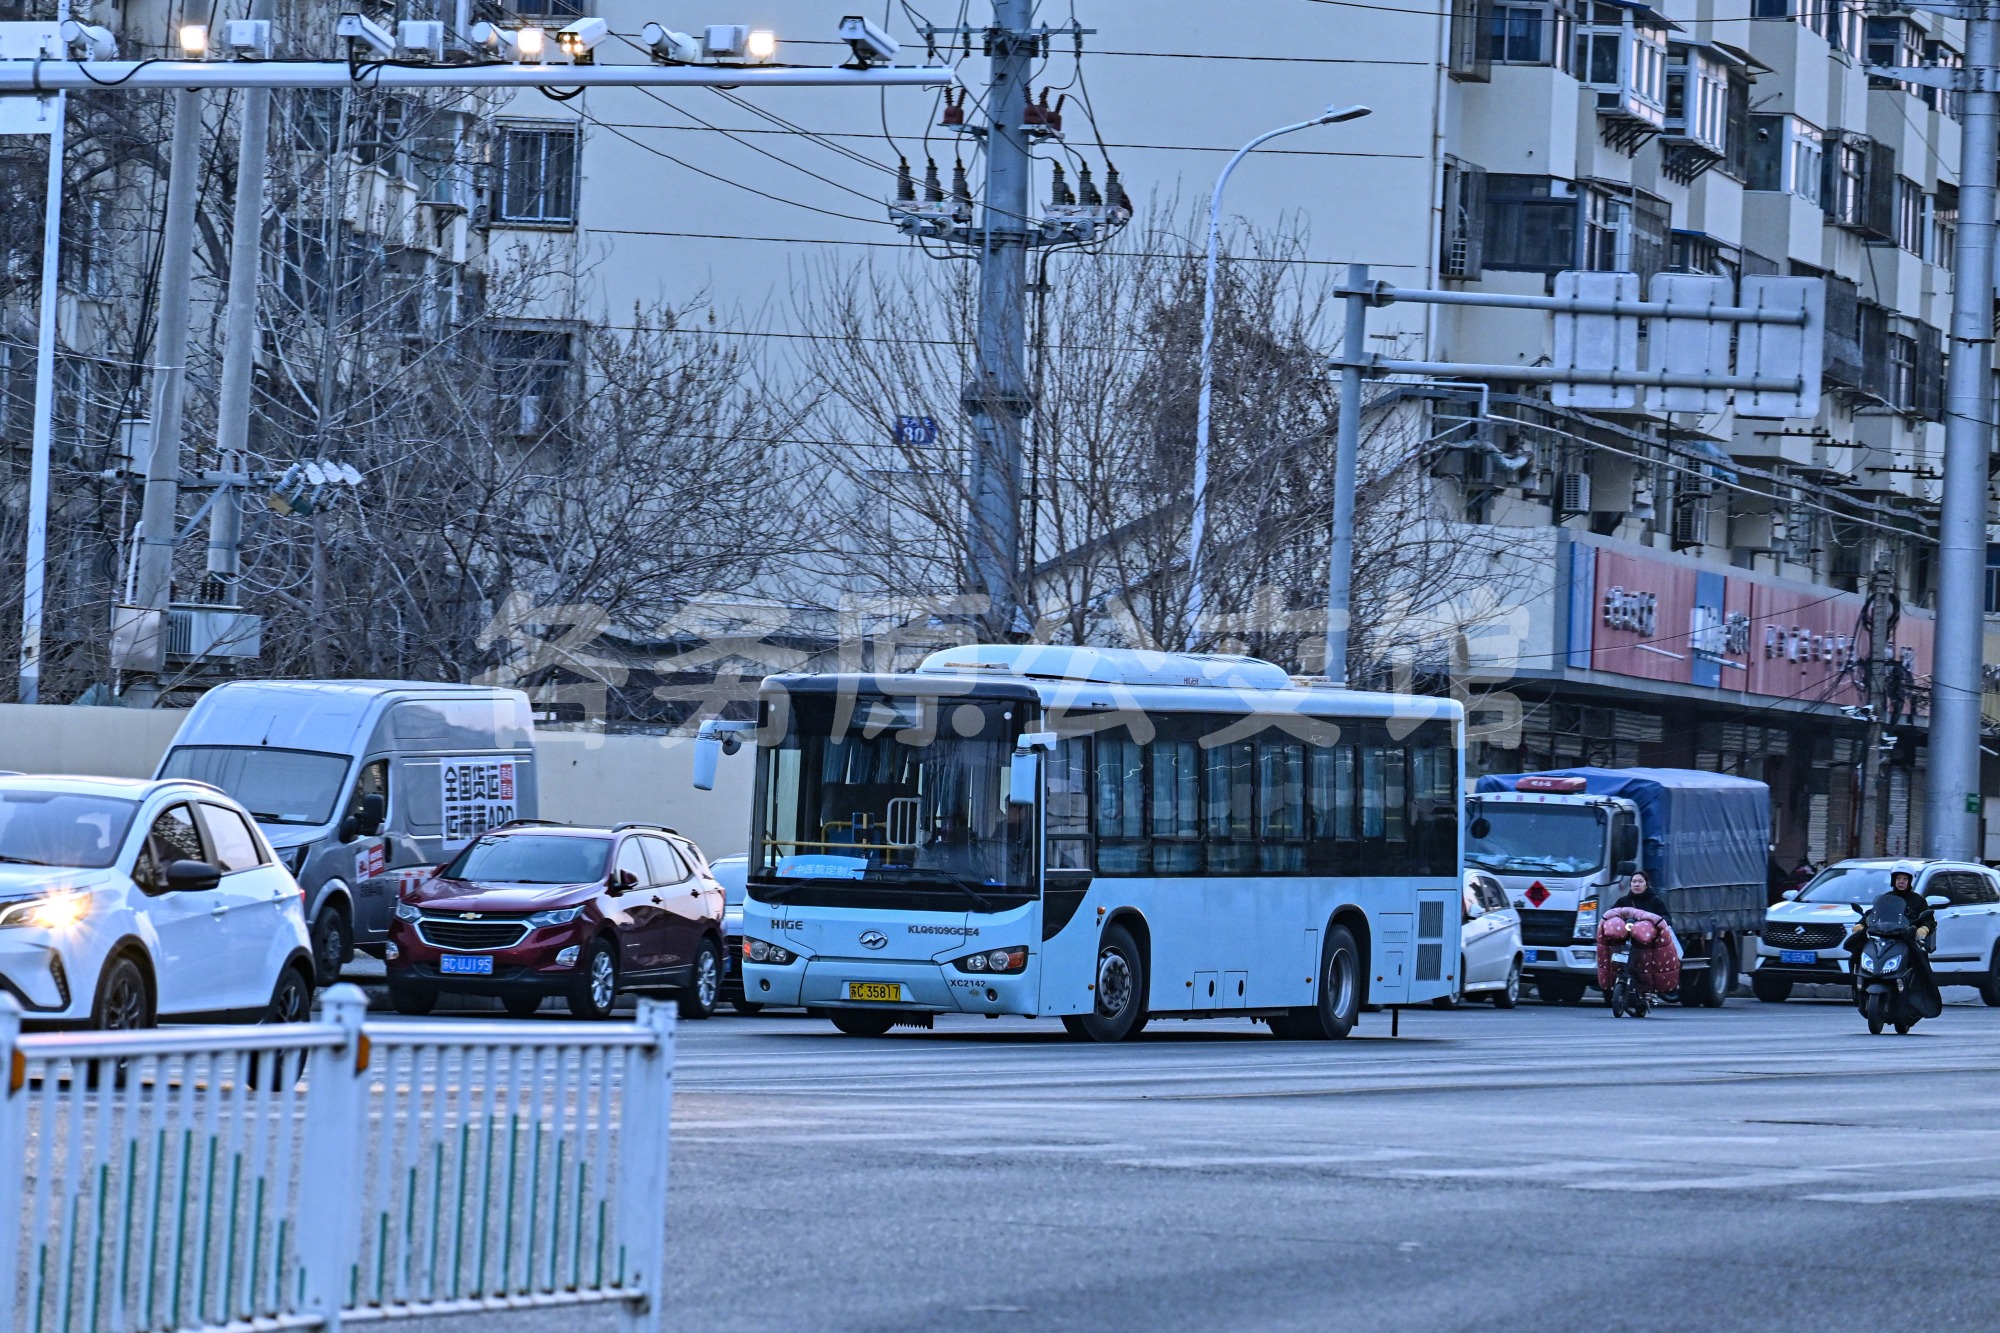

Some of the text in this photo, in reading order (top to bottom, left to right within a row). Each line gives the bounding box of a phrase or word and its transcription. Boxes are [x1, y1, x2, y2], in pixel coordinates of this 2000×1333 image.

[445, 766, 499, 801] 全国货运
[771, 919, 803, 930] HIGE
[950, 979, 986, 988] XC2142
